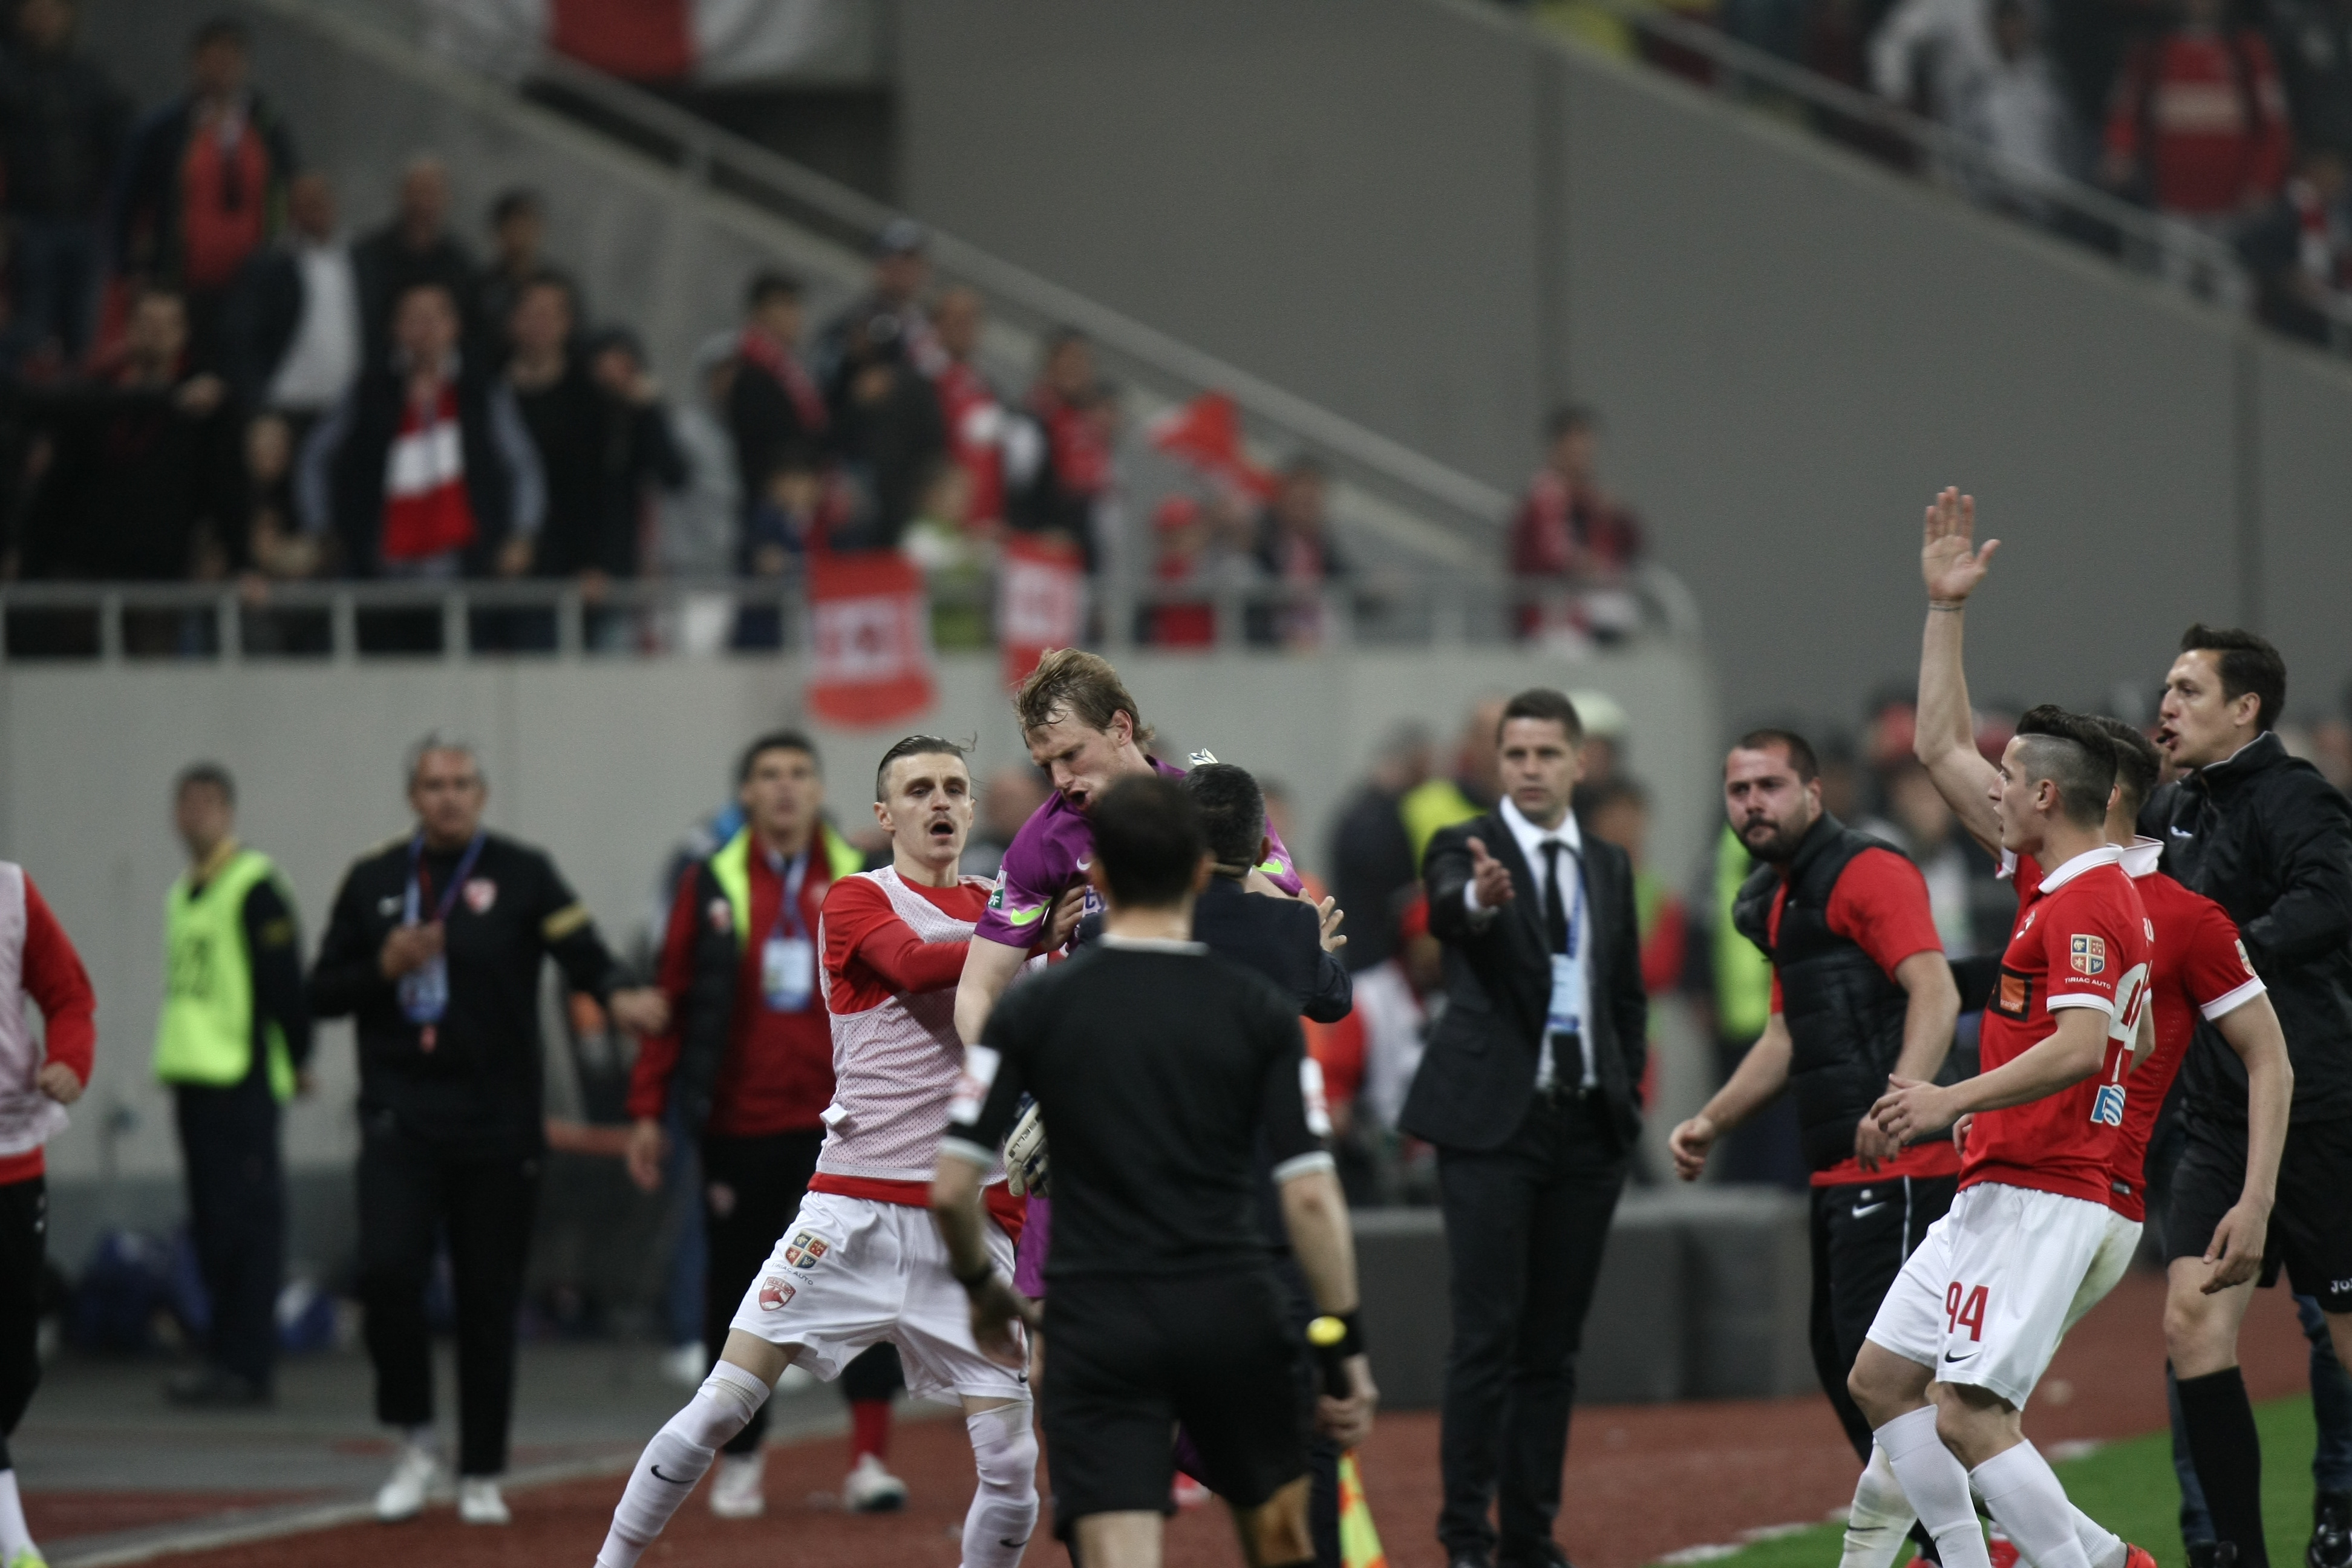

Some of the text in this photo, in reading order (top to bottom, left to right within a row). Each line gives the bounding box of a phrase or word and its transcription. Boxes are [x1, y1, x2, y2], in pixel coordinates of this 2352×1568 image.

[2091, 979, 2111, 989] AUTO
[771, 1262, 814, 1285] TIRIAC AUTO
[2330, 1278, 2352, 1293] JO
[1946, 1281, 1989, 1342] 94
